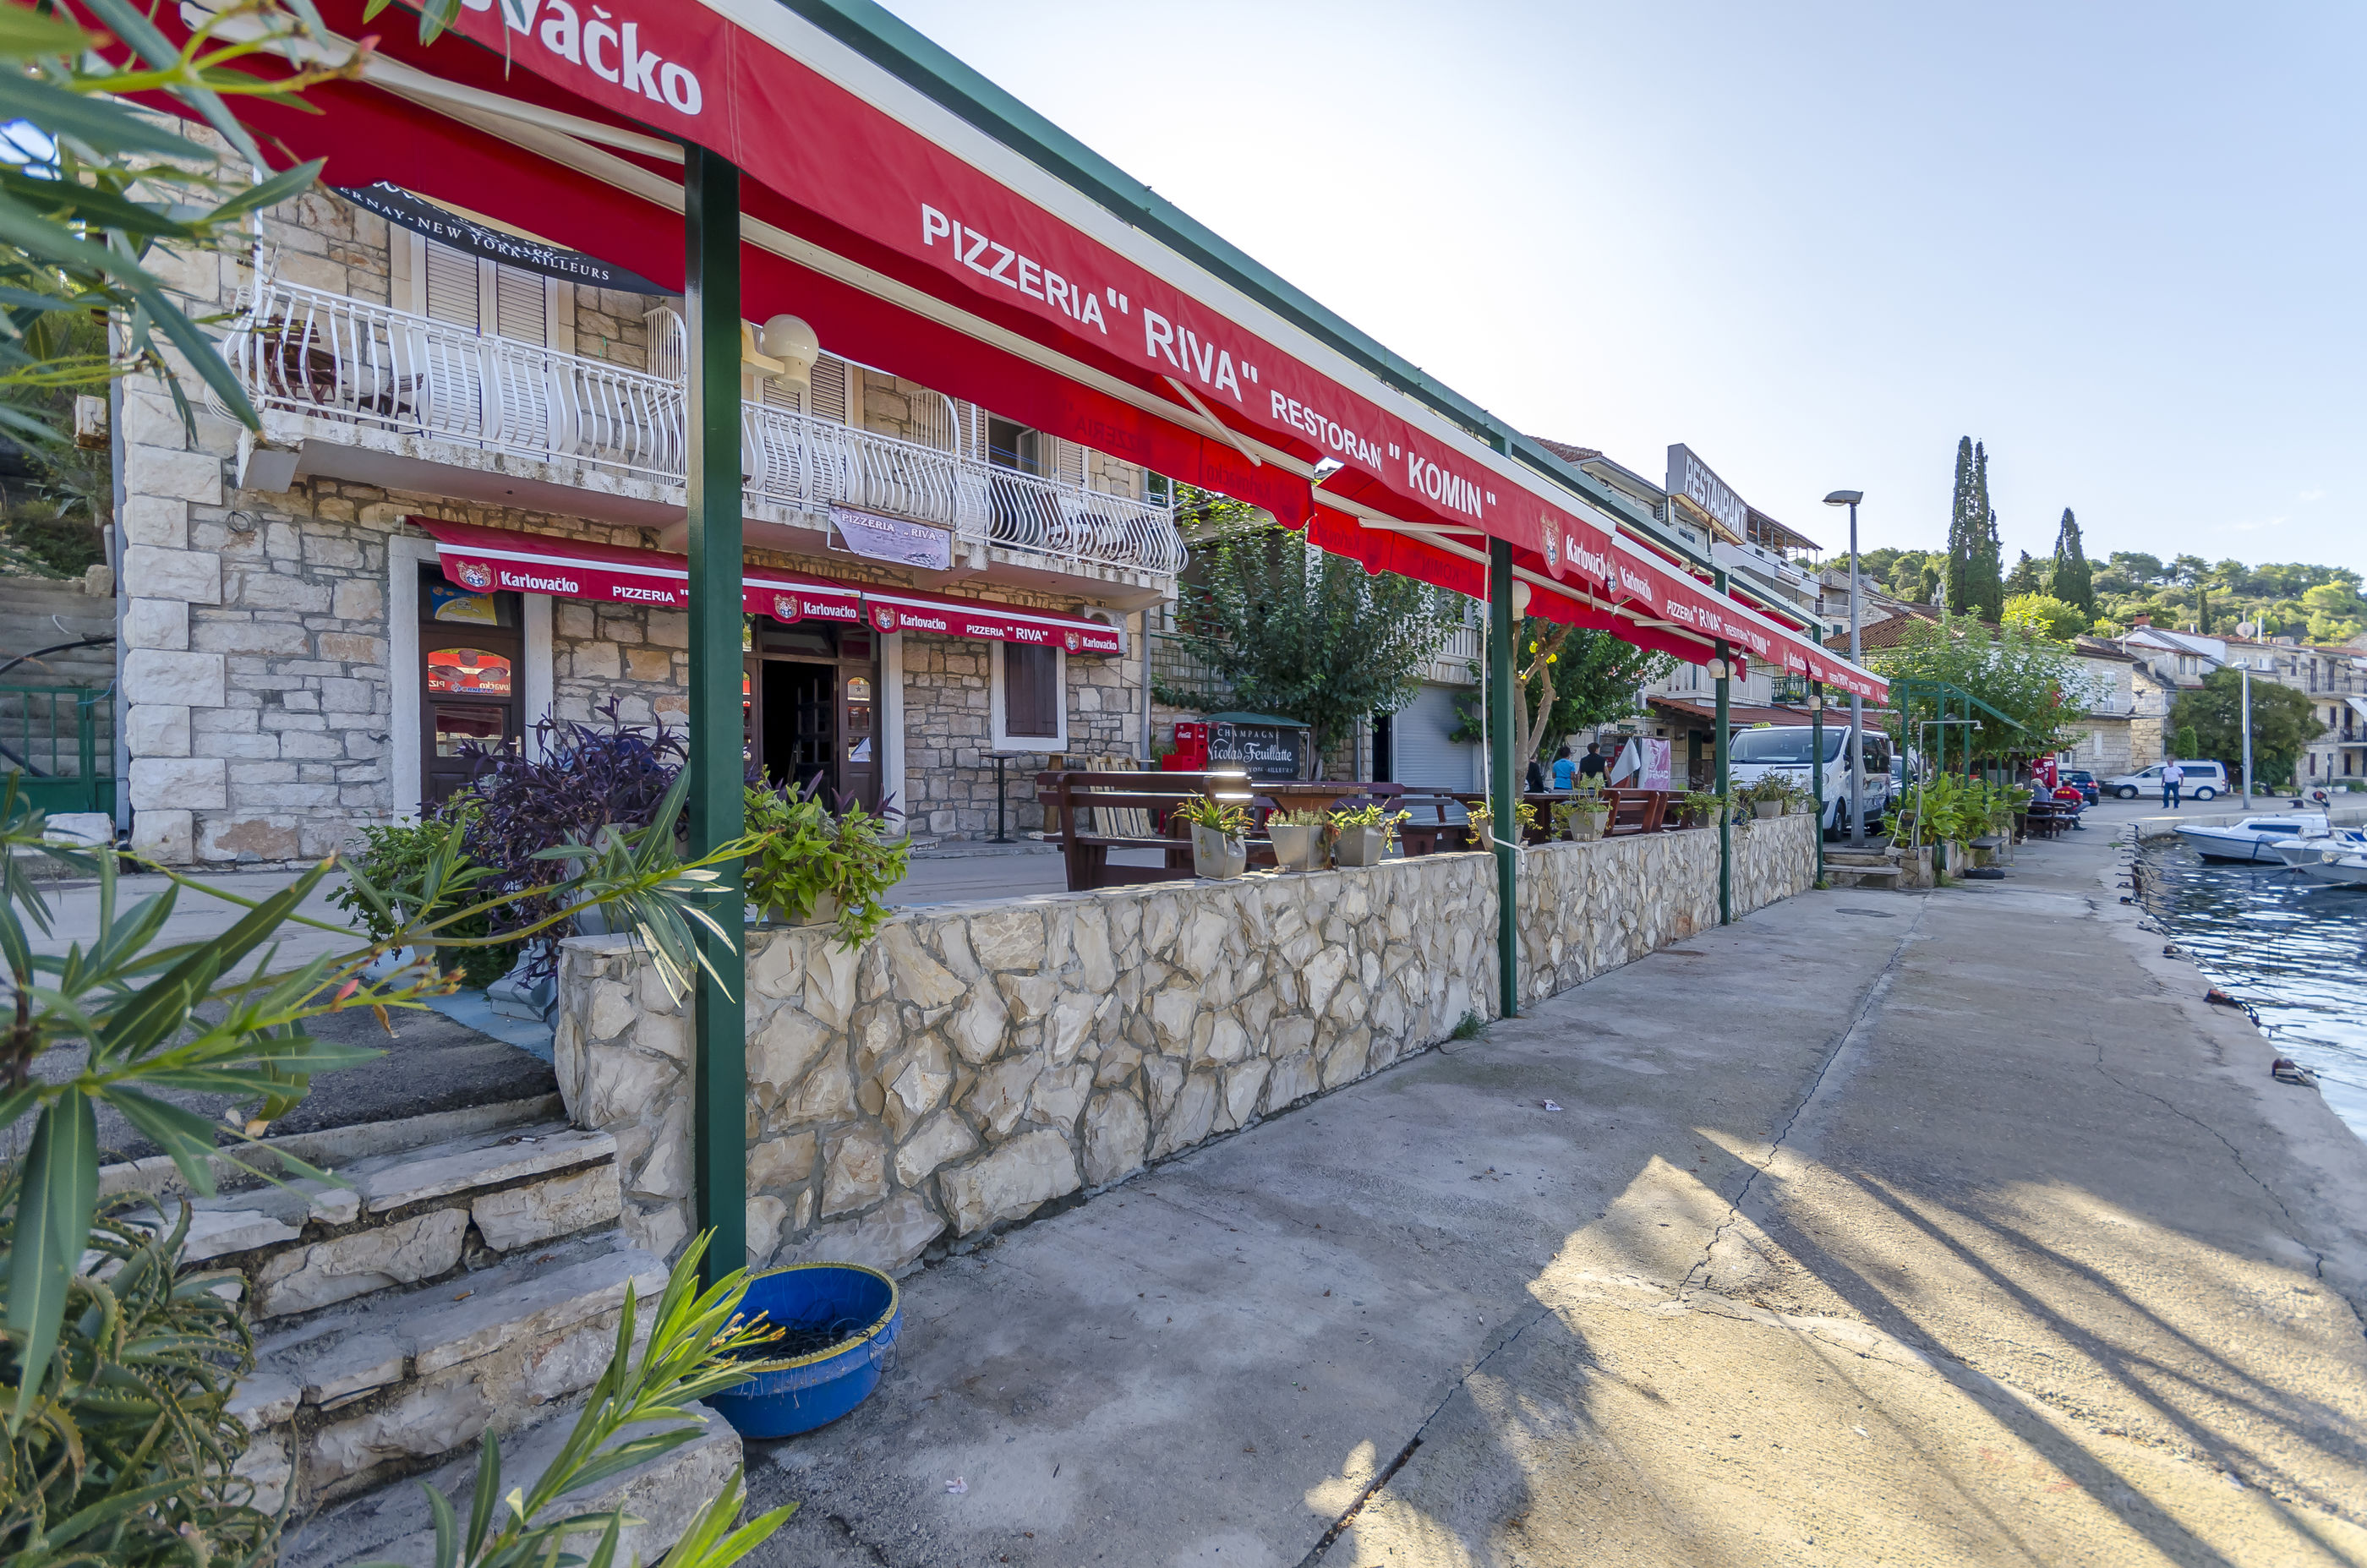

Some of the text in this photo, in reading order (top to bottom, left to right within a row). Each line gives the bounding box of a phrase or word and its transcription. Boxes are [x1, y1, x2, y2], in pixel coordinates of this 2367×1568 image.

[461, 0, 702, 116] vačko
[921, 203, 1107, 336] PIZZERIA
[1271, 389, 1382, 473] RESTORAN
[1685, 455, 1746, 538] RESTAURANT
[841, 513, 895, 533] PIZZERIA
[500, 571, 675, 603] Karlovačko PIZZERIA
[804, 602, 857, 619] Karlovačko
[1666, 599, 1695, 624] PIZZERIA
[900, 613, 946, 631] Karlovačko
[966, 625, 1004, 637] PIZZERIA
[1082, 636, 1118, 651] Karlovačko
[1208, 738, 1292, 762] Nicolas Feuillatte
